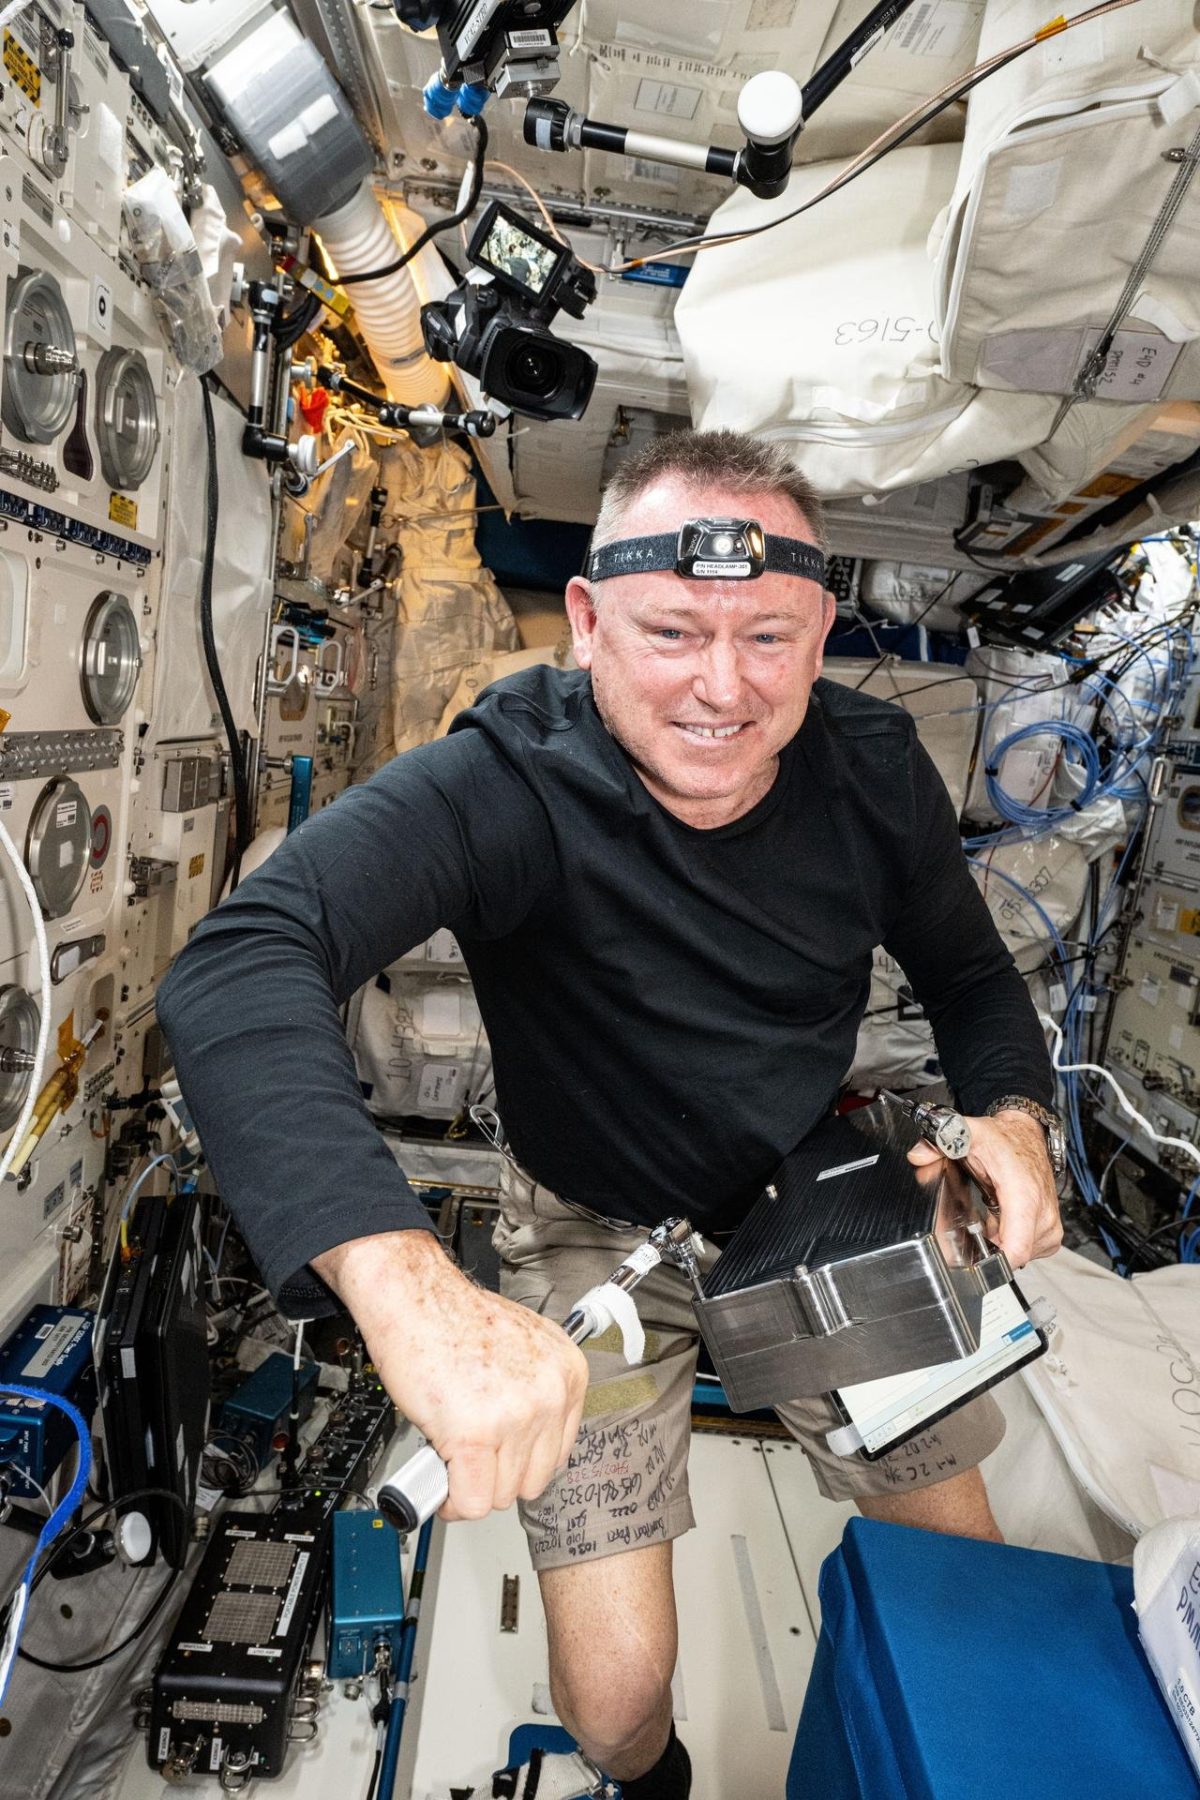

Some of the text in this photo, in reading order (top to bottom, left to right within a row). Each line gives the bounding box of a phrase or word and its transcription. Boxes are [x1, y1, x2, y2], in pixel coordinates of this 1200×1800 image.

[613, 548, 655, 563] TIKKA
[1176, 1585, 1200, 1658] PMM
[1182, 1692, 1196, 1717] CTB
